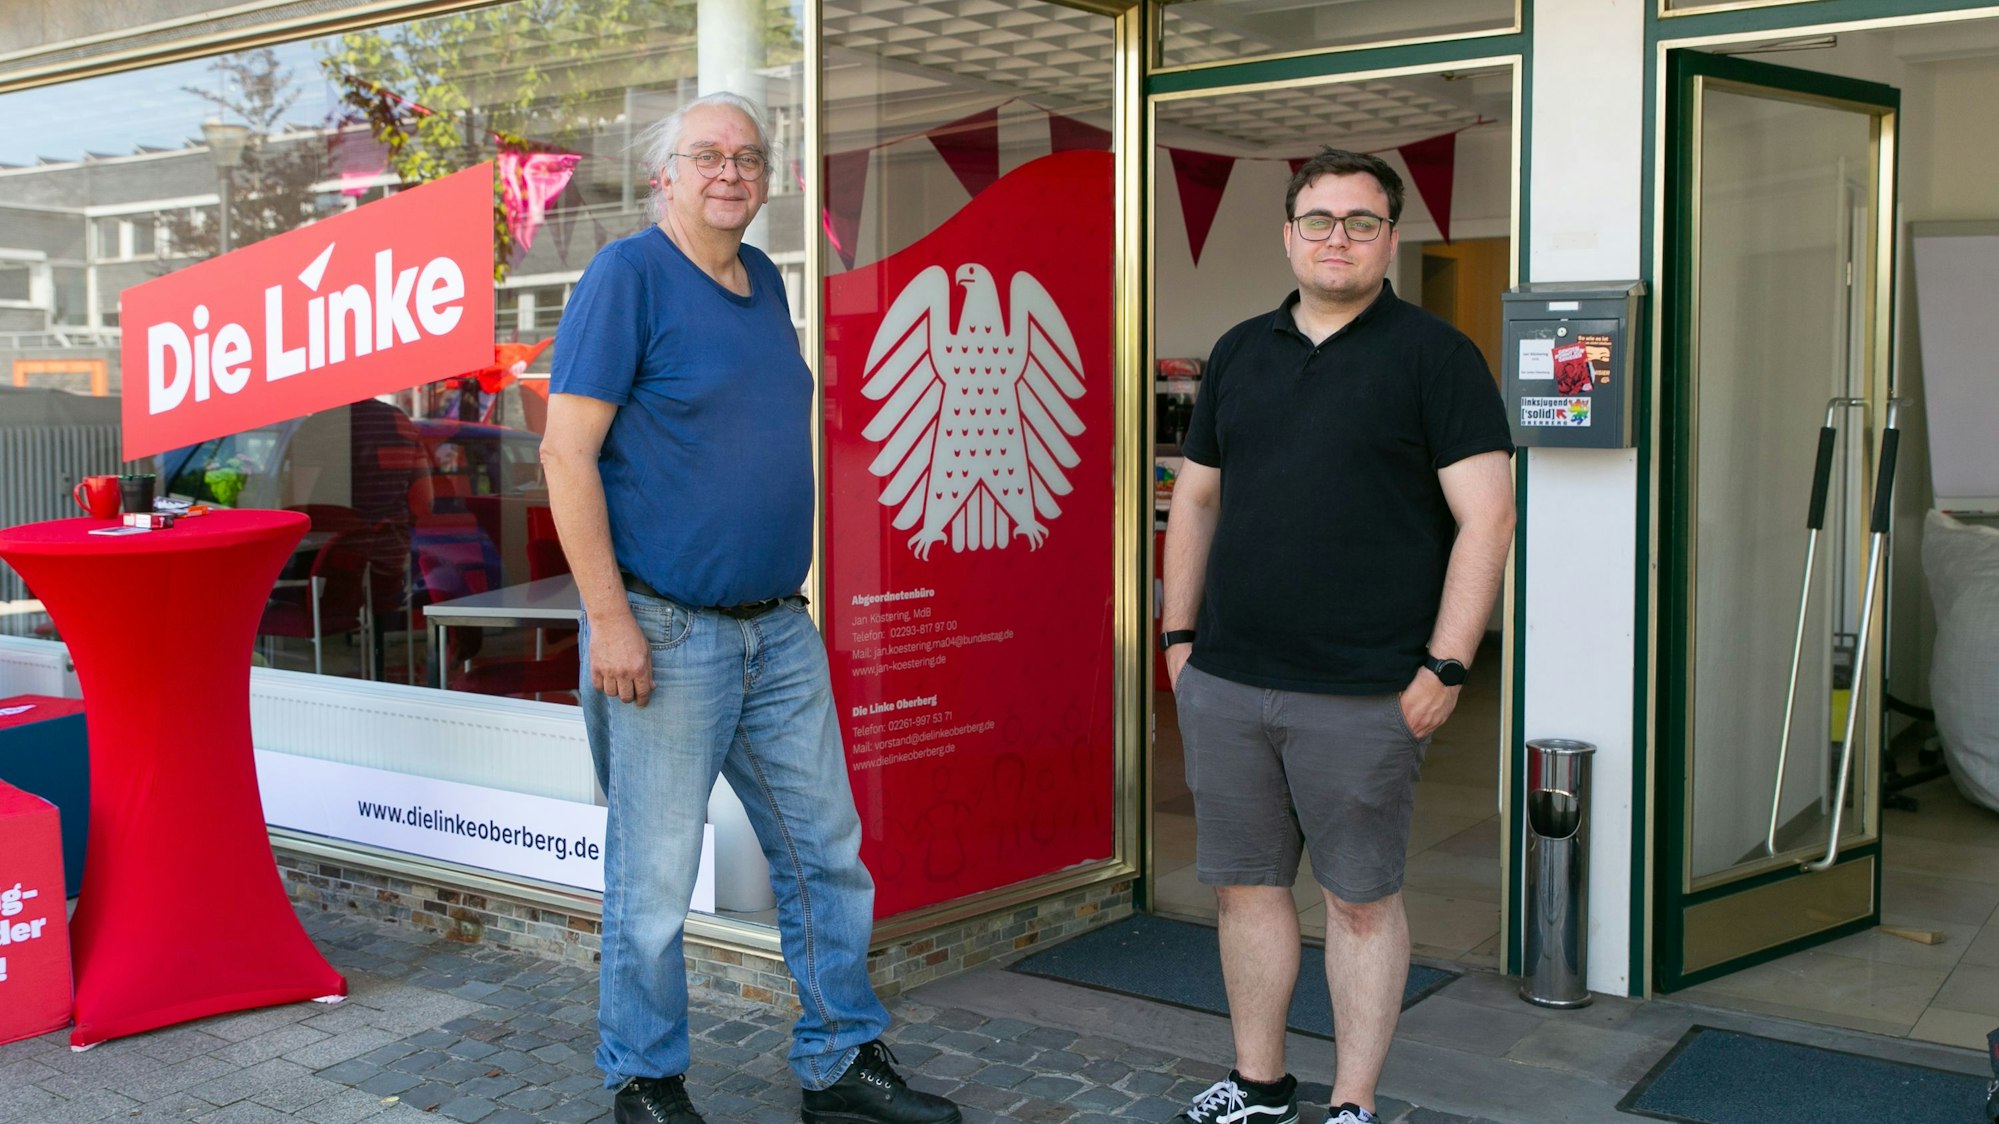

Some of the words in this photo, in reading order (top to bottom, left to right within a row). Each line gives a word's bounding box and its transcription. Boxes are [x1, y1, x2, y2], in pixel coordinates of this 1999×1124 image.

[148, 304, 252, 415] Die
[264, 241, 465, 382] Linke
[1521, 398, 1568, 407] linksjugend
[851, 588, 935, 606] Abgeordnetenbüro
[852, 615, 868, 626] Jan
[913, 607, 932, 618] MdB
[852, 630, 885, 643] Telefon:
[890, 623, 933, 637] 02293-817
[934, 622, 948, 632] 97
[946, 620, 957, 630] 00
[852, 648, 872, 660] Mail:
[852, 654, 946, 677] www.jan-koestering.de
[852, 706, 868, 717] Die
[869, 701, 894, 714] Linke
[896, 694, 938, 710] Oberberg
[852, 724, 886, 737] Telefon:
[888, 714, 930, 731] 02261-997
[932, 713, 943, 723] 53
[944, 710, 953, 721] 71
[852, 741, 873, 754] Mail:
[874, 720, 995, 751] vorstand@dielinkeoberberg.de
[852, 743, 956, 771] www.dielinkeoberberg.de
[357, 800, 600, 861] www.dielinkeoberberg.de
